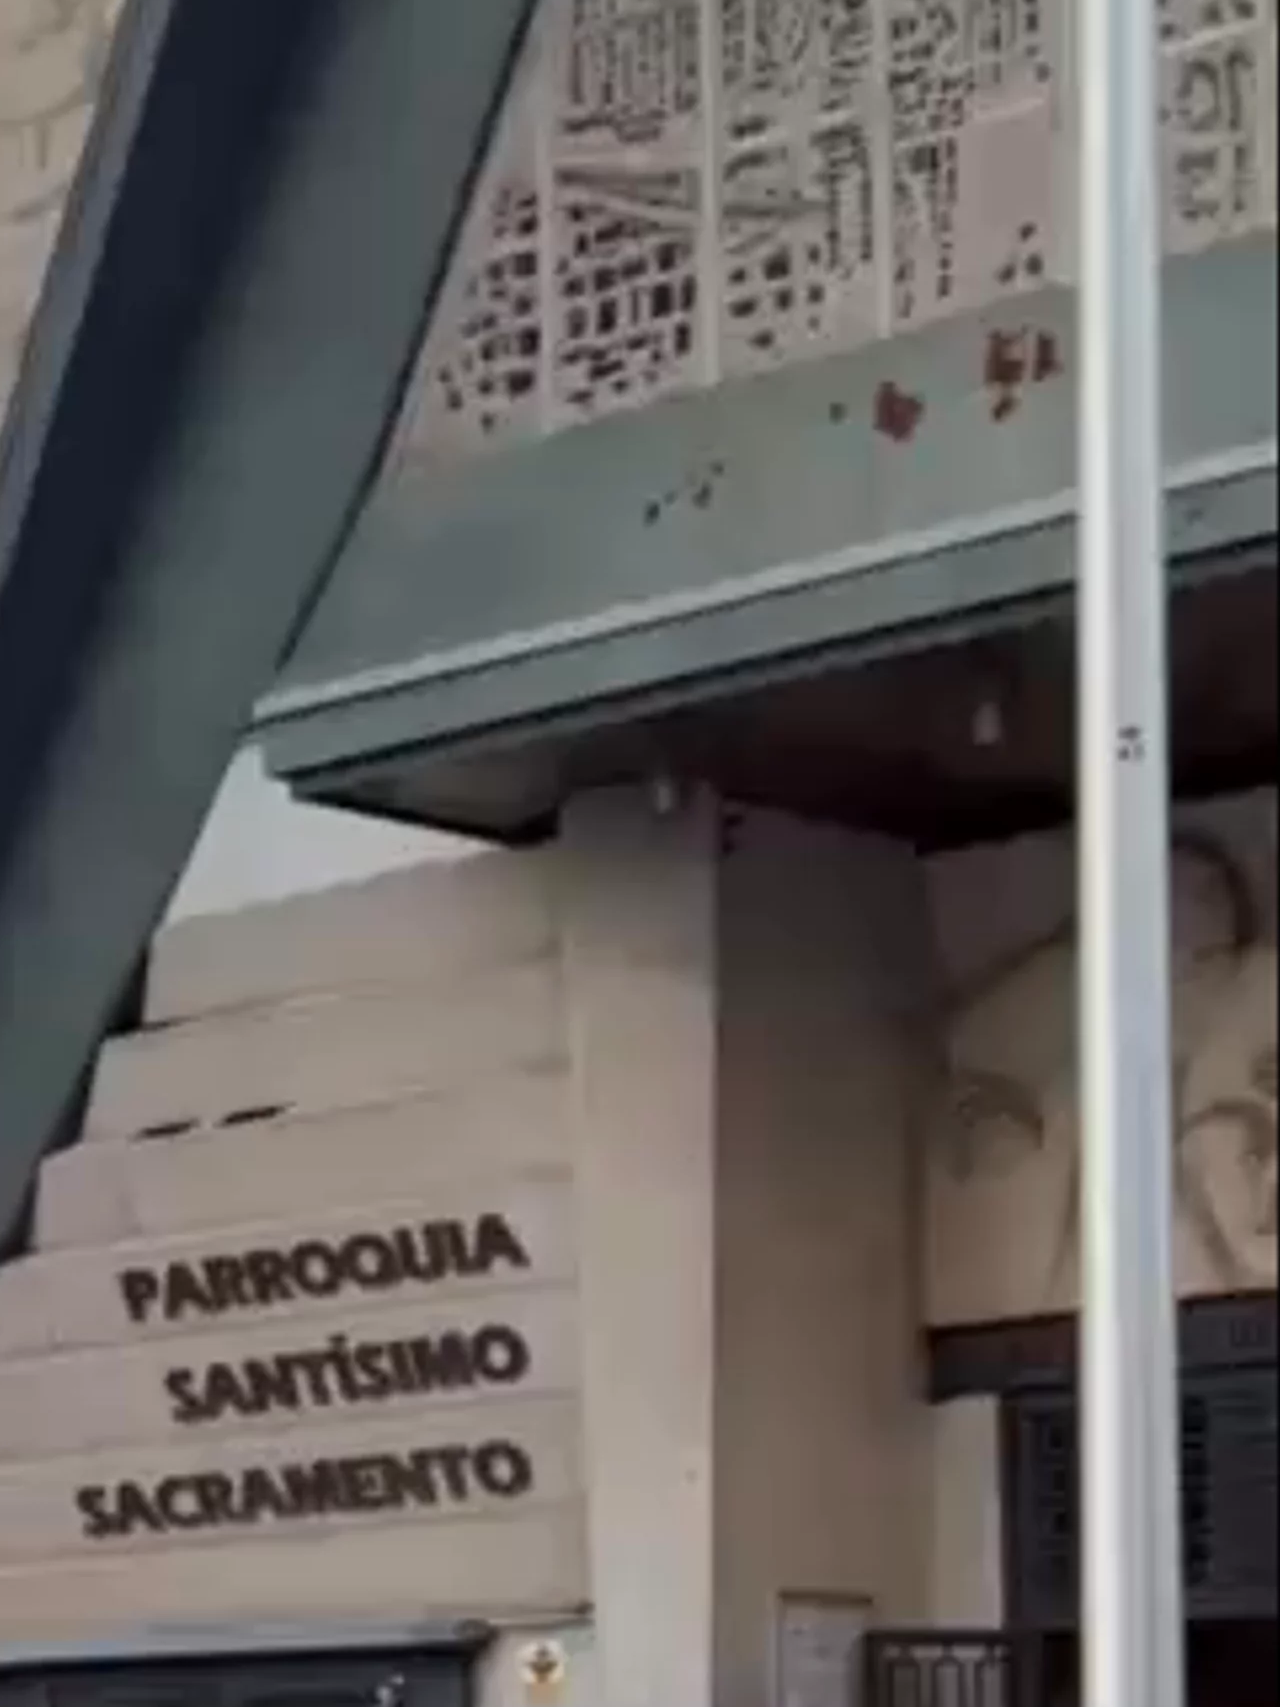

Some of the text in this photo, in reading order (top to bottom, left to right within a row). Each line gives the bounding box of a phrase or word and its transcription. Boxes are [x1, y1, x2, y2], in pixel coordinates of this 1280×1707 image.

[118, 1212, 531, 1324] PARROQUIA
[163, 1324, 530, 1424] SANTÍSIMO
[75, 1440, 533, 1539] SACRAMENTO
